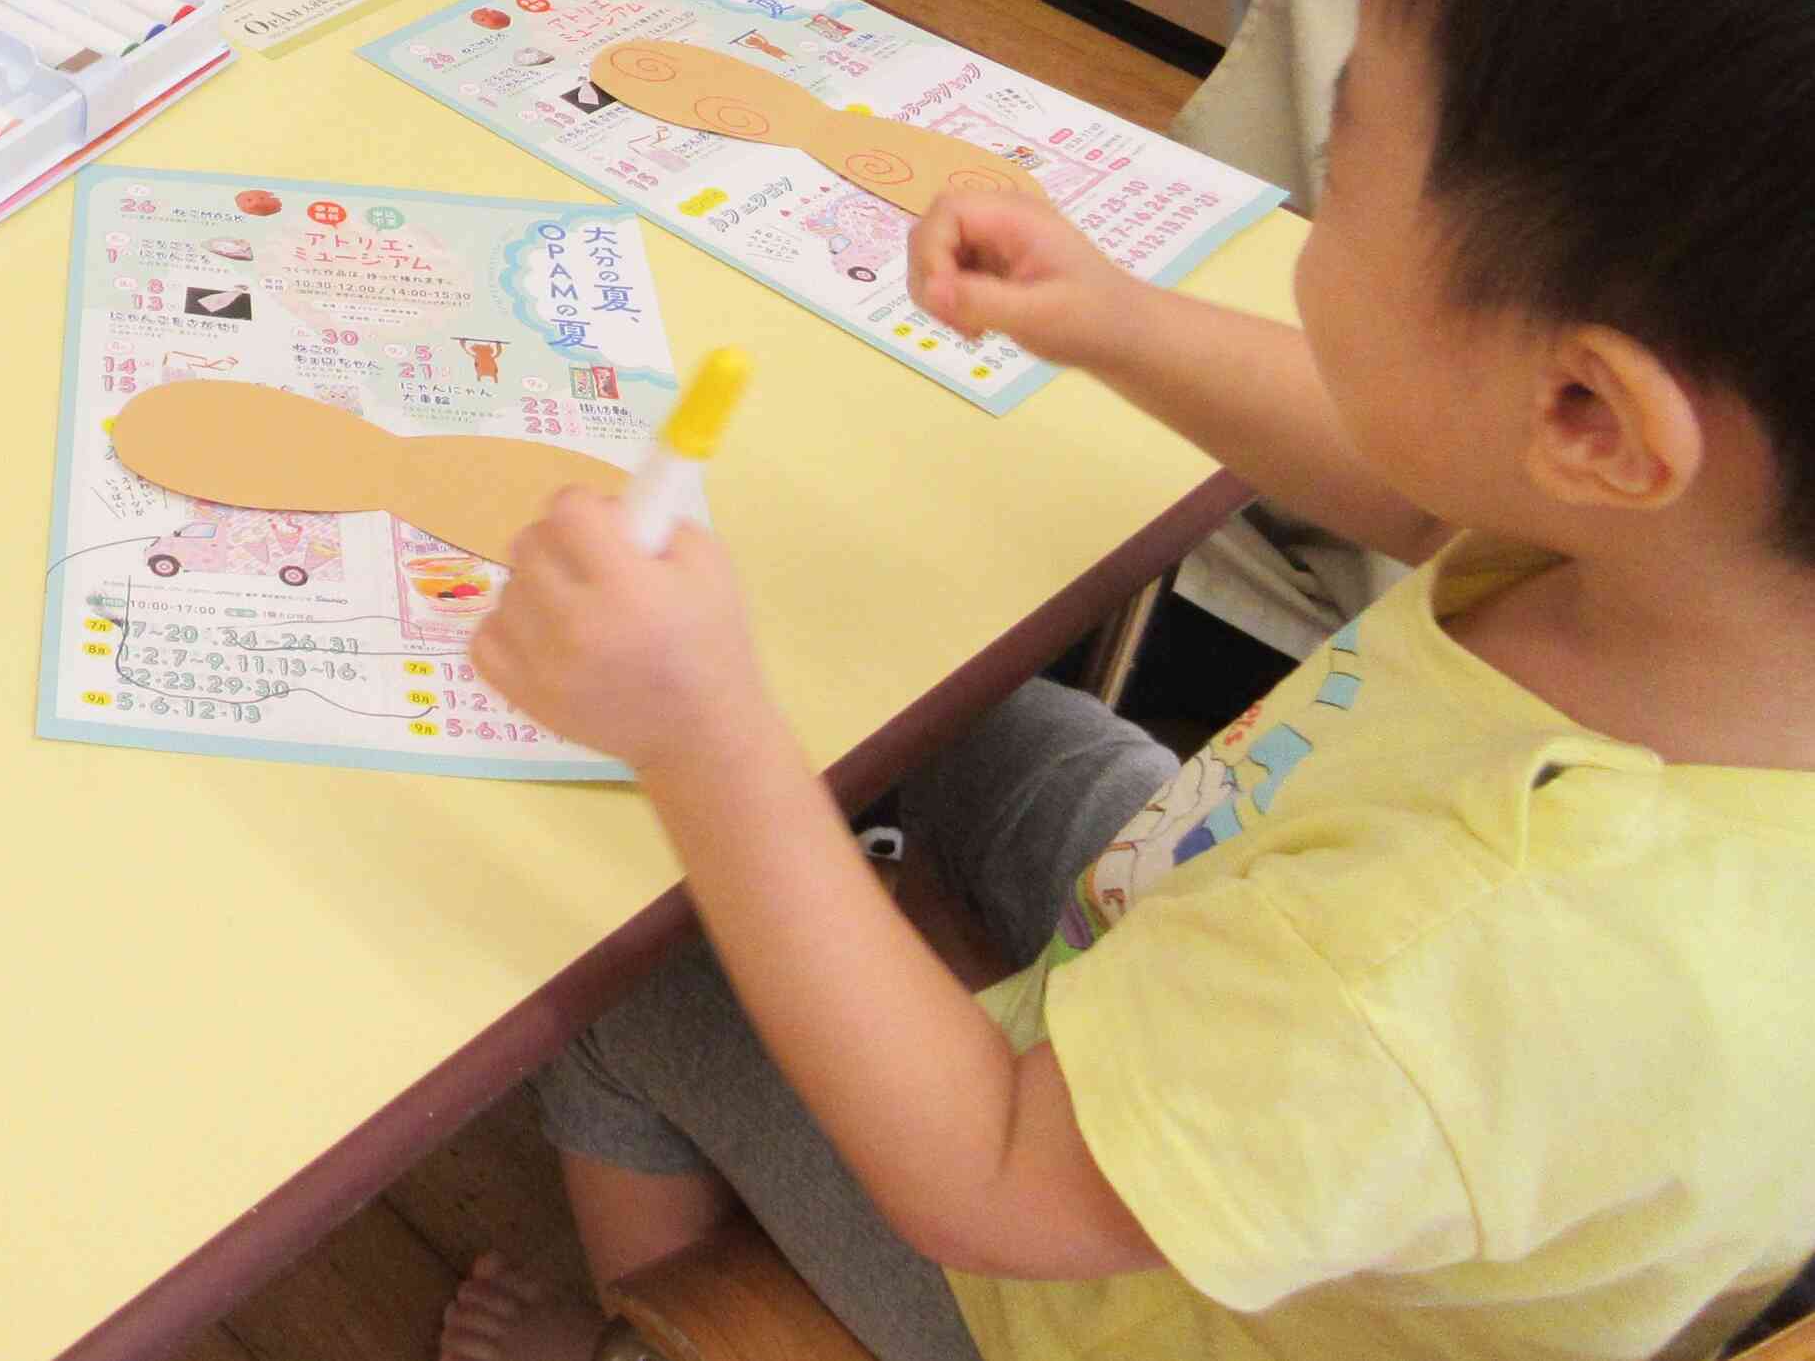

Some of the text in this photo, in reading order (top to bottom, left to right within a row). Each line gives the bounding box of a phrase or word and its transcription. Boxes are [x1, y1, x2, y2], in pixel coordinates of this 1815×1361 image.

[120, 198, 157, 214] 26
[293, 246, 434, 271] ミュージアム
[583, 227, 642, 323] 大分の夏、
[538, 225, 598, 349] OPAMの夏
[321, 328, 359, 346] 30
[414, 345, 433, 362] 5
[104, 355, 137, 375] 14
[398, 361, 434, 379] 21
[103, 375, 137, 393] 15
[400, 382, 494, 398] にゃんにゃん
[519, 396, 560, 417] 22
[524, 416, 562, 435] 23
